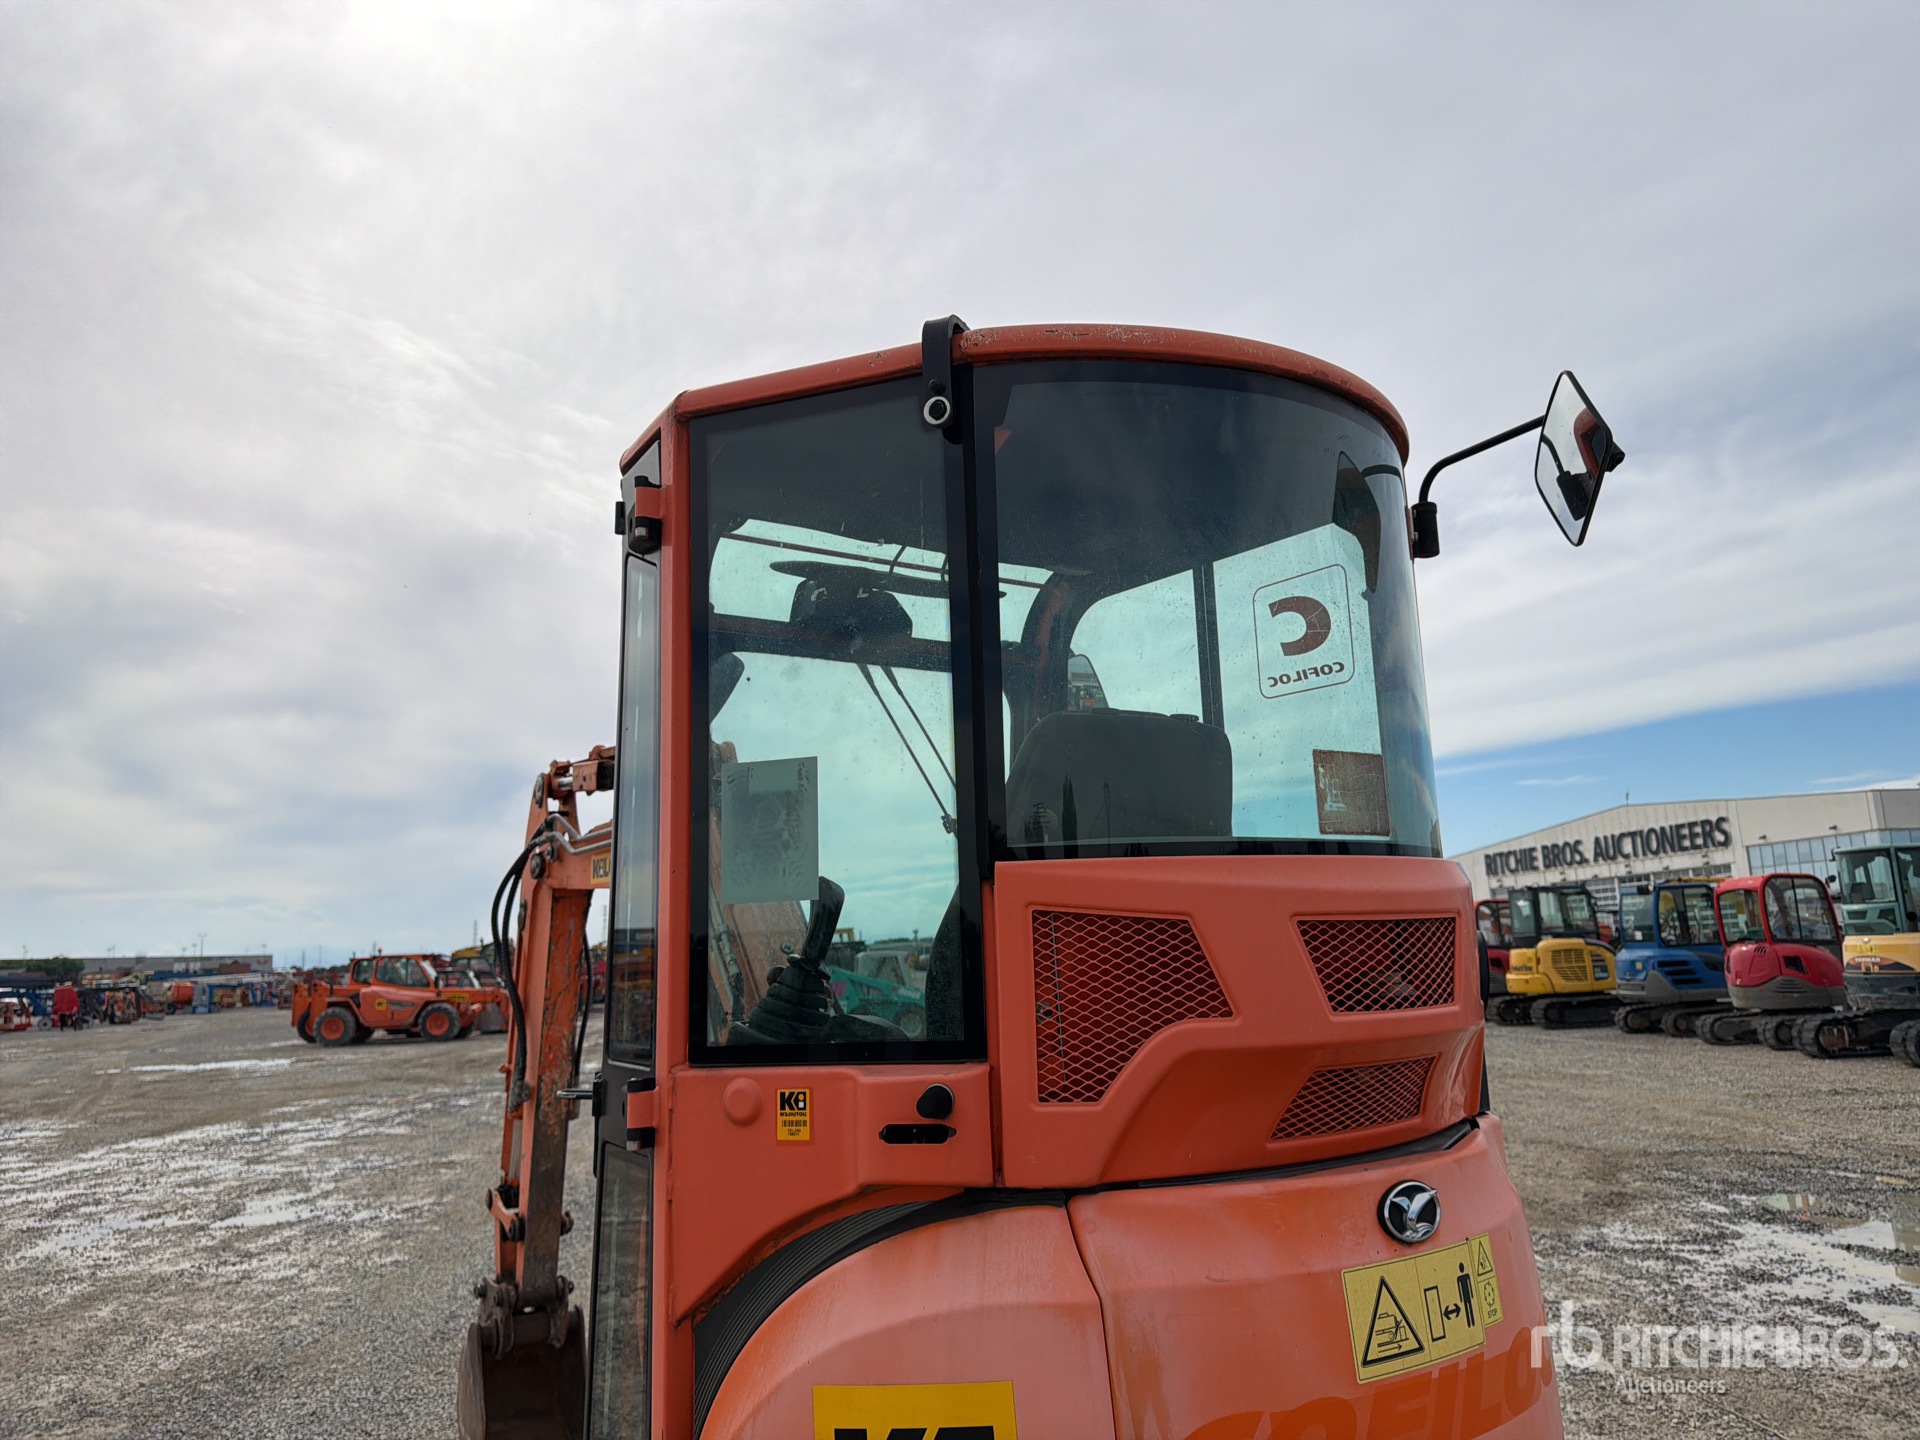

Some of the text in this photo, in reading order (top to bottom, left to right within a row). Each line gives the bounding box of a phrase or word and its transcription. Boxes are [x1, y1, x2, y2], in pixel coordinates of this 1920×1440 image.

[1484, 817, 1731, 876] RITCHIE BROS. AUCTIONEERS
[1487, 1307, 1498, 1319] STOP
